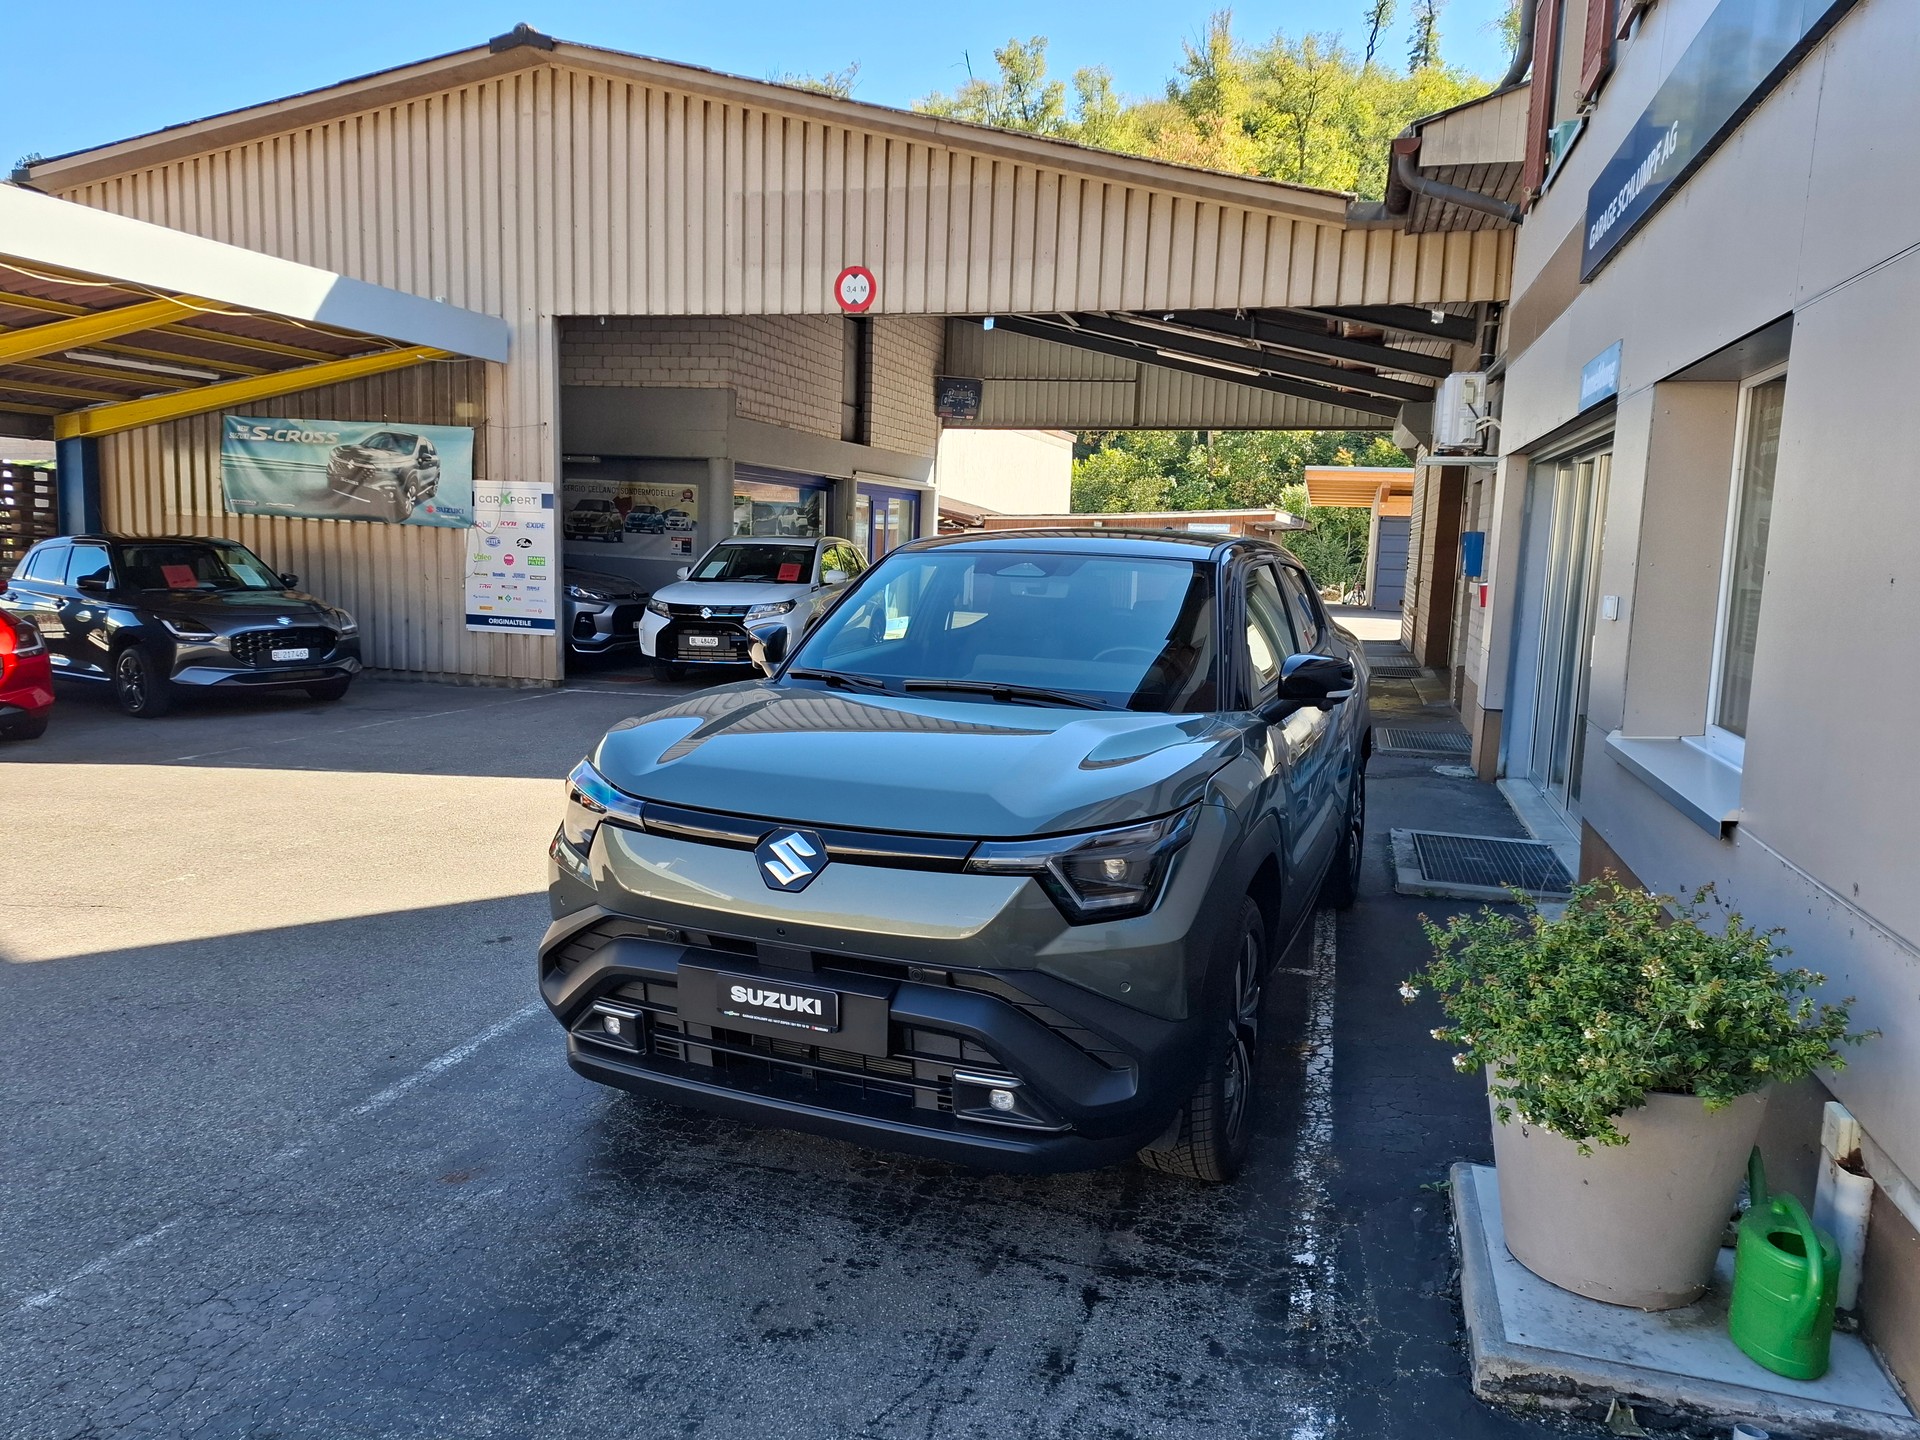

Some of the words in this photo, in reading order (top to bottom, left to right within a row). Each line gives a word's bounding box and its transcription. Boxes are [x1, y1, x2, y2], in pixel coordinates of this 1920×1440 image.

[1589, 196, 1617, 250] GARAGE
[1617, 139, 1662, 218] SCHLUMPF
[1661, 120, 1678, 165] AG
[250, 426, 340, 444] S-CROSS
[563, 484, 586, 493] SERGIO
[620, 487, 675, 497] SONDERMODELLE
[436, 506, 464, 514] SUZUKI
[488, 618, 532, 627] ORIGINALTEILE
[273, 651, 282, 659] BL
[730, 985, 822, 1015] SUZUKI
